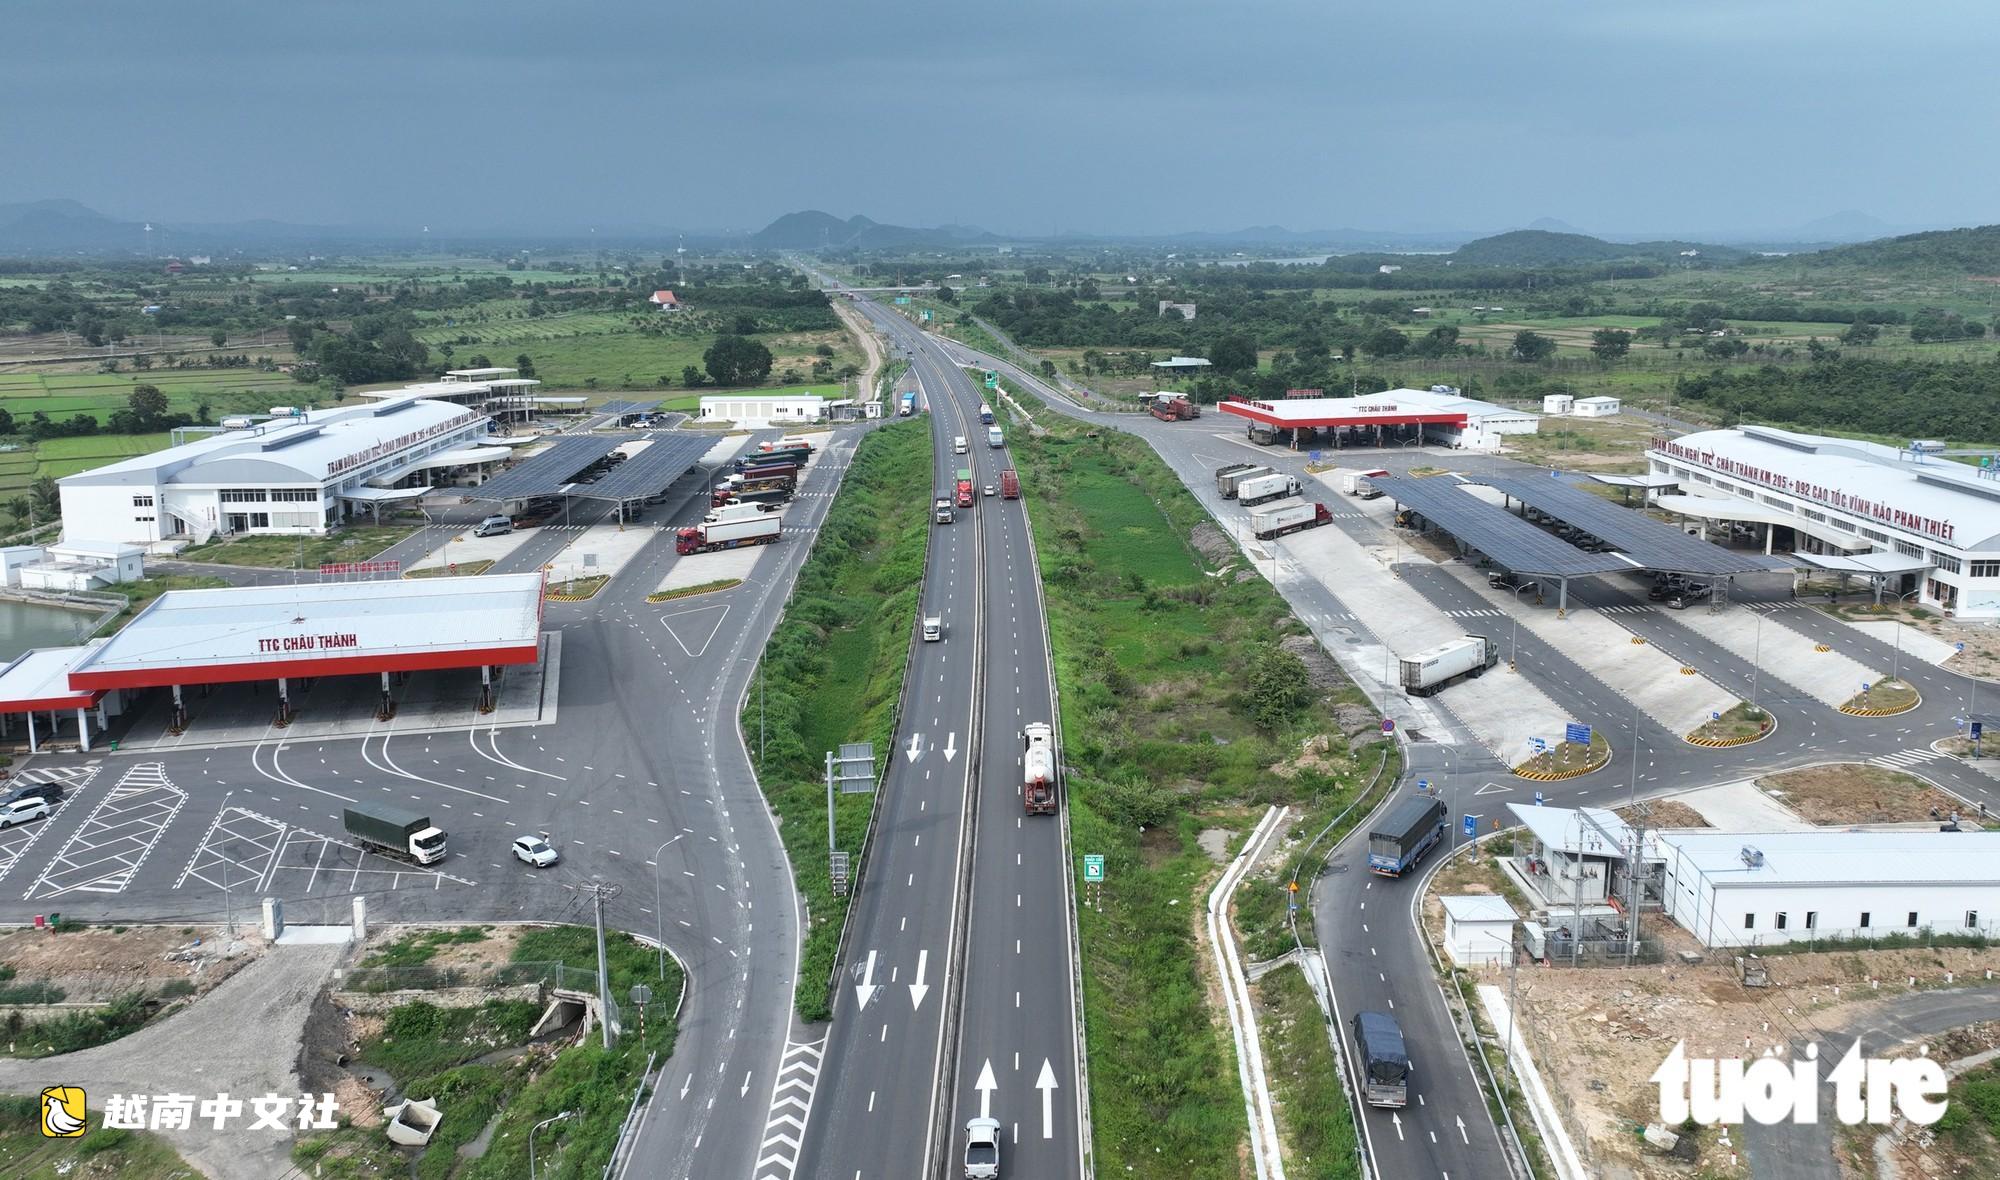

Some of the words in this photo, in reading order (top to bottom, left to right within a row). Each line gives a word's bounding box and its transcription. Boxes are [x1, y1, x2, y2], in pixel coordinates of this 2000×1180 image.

[1760, 469, 1771, 484] KM
[1773, 473, 1787, 489] 205
[1812, 485, 1828, 502] CAO
[1831, 488, 1847, 508] TỐC
[1849, 494, 1870, 515] VĨNH
[1873, 501, 1892, 522] HẢO
[1894, 509, 1921, 531] PHAN
[1923, 518, 1955, 541] THIẾT
[258, 639, 280, 652] TTC
[283, 633, 315, 651] CHÂU
[317, 631, 357, 648] THÀNH
